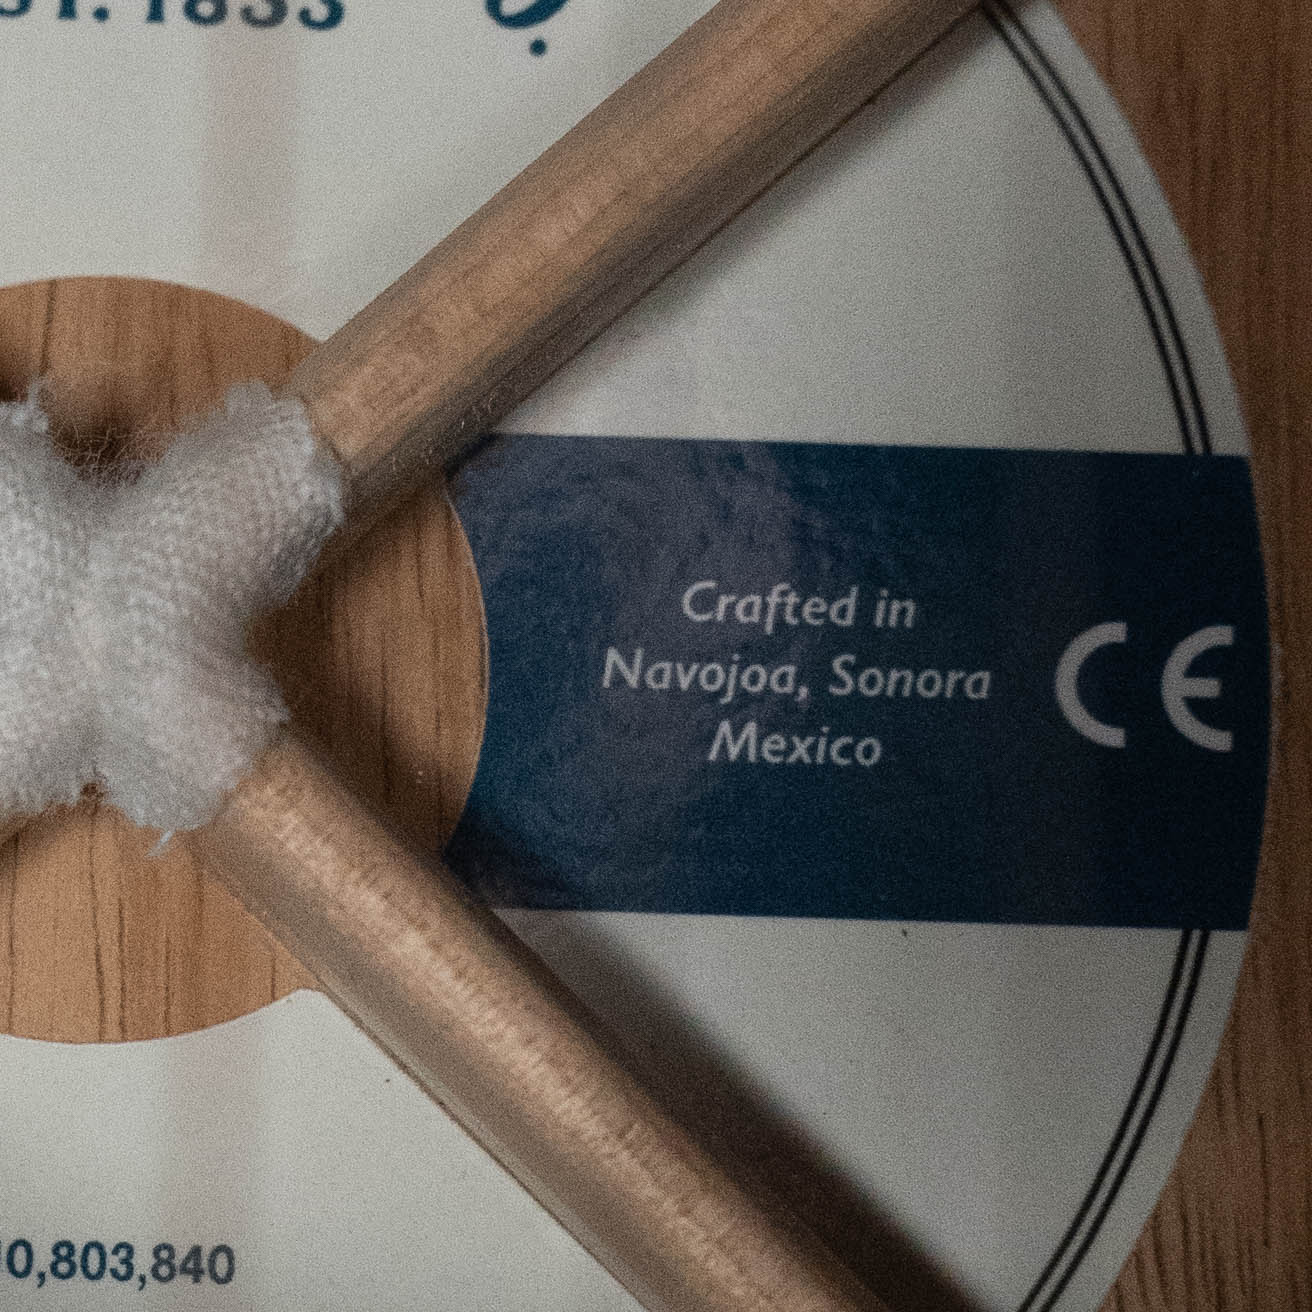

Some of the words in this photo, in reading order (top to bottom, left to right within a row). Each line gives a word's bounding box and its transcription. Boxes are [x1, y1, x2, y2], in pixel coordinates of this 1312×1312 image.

[681, 580, 860, 636] Crafted
[875, 588, 918, 629] in
[601, 646, 811, 702] Navojoa,
[828, 653, 991, 701] Sonora
[708, 720, 883, 768] Mexico
